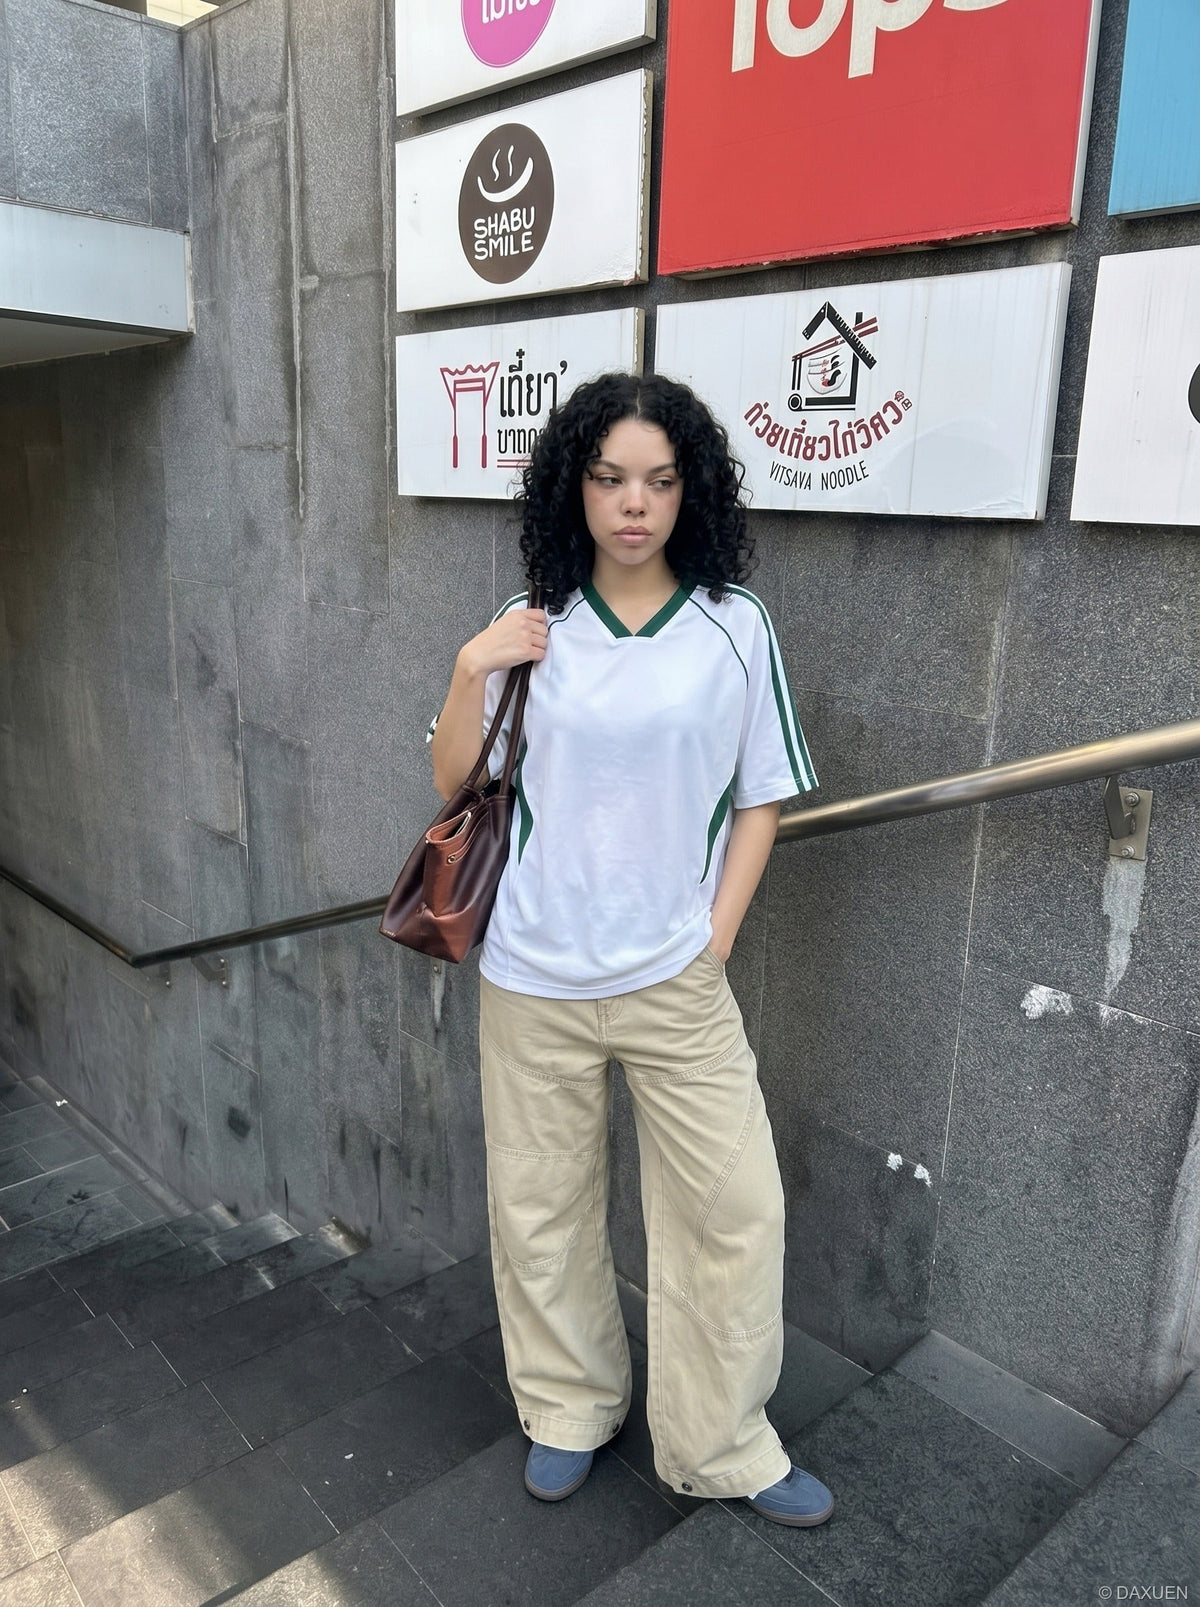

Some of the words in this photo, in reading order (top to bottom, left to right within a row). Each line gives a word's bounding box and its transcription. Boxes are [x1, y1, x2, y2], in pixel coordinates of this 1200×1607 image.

[473, 206, 535, 239] SHABU
[474, 231, 534, 260] SMILE
[769, 461, 812, 491] VITSAVA
[821, 460, 869, 491] NOODLE
